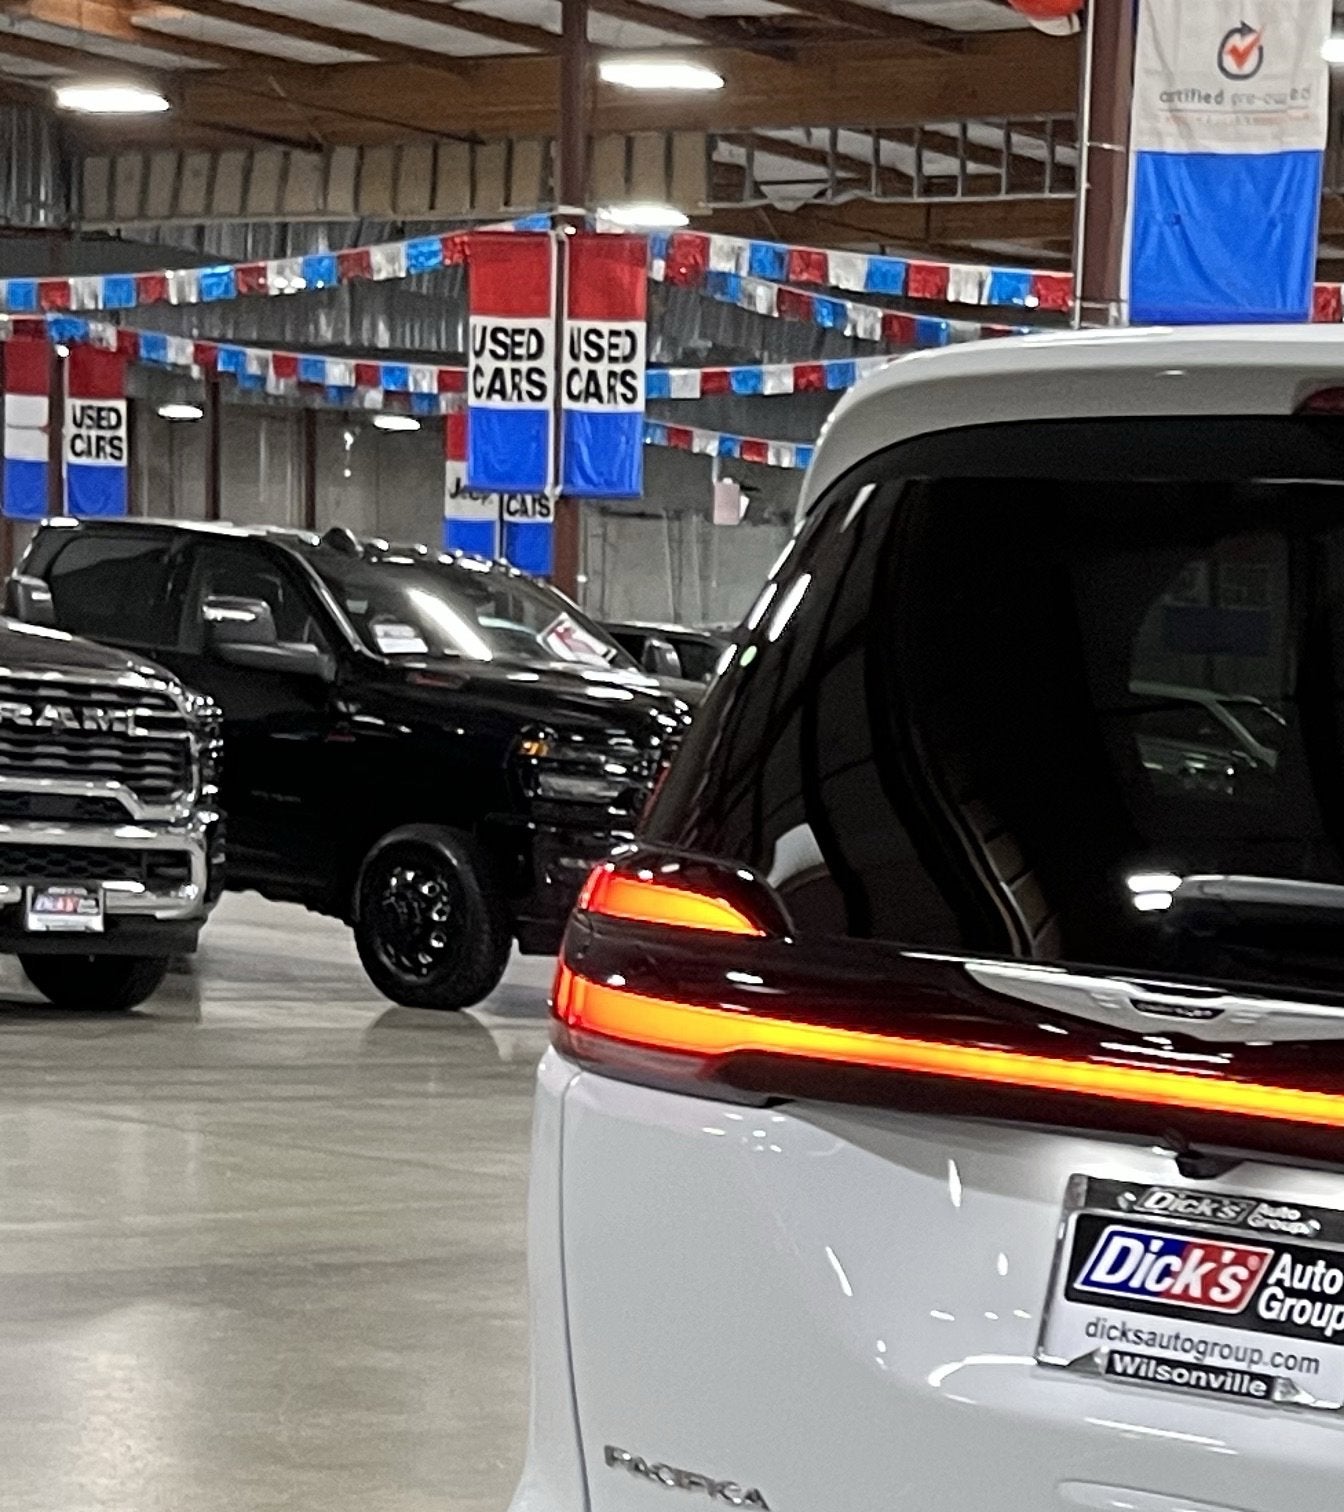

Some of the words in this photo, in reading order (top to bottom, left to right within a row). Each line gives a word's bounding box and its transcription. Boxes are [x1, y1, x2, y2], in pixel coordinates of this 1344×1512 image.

[472, 324, 545, 361] USED
[569, 327, 637, 363] USED
[472, 365, 547, 401] CARS
[566, 367, 638, 404] CARS
[72, 404, 121, 429] USED
[1090, 1236, 1248, 1302] Dick's
[1267, 1252, 1344, 1294] Auto
[1085, 1318, 1319, 1374] dicksautogroup.com
[1113, 1354, 1267, 1396] Wilsonville
